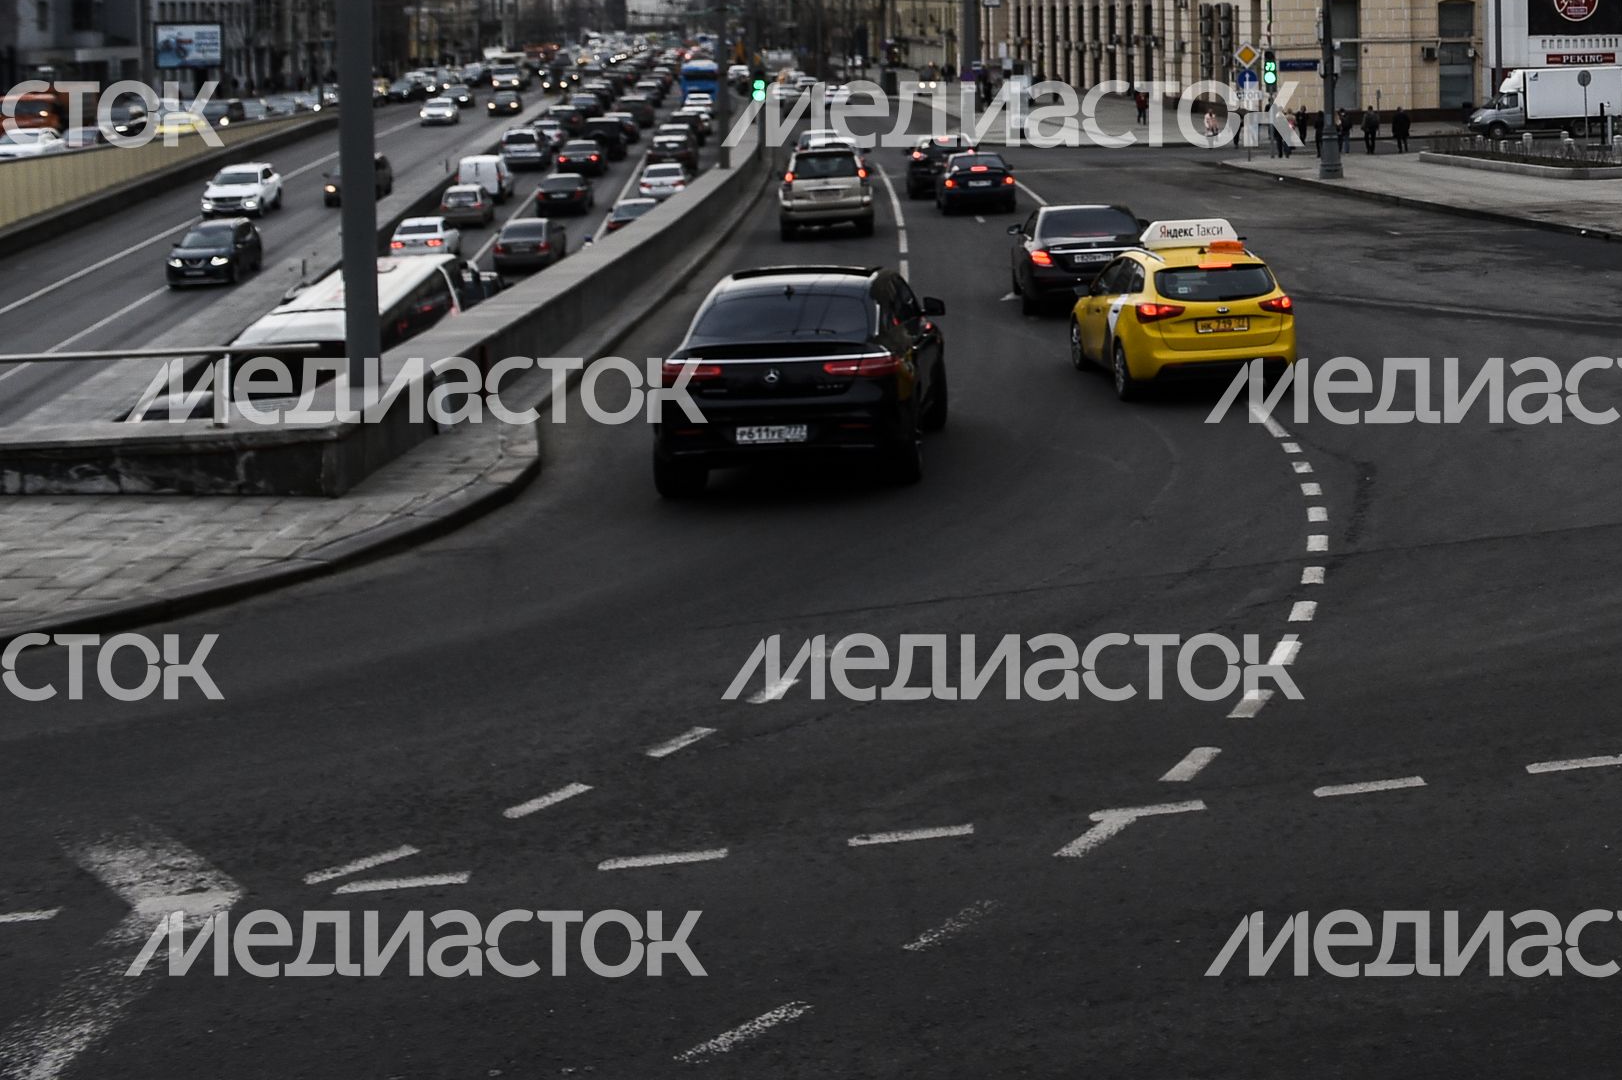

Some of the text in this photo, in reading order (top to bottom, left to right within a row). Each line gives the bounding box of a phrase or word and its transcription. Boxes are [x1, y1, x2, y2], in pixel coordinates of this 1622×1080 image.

[1562, 54, 1603, 64] PEKING
[1159, 224, 1223, 238] Яндекс Такси
